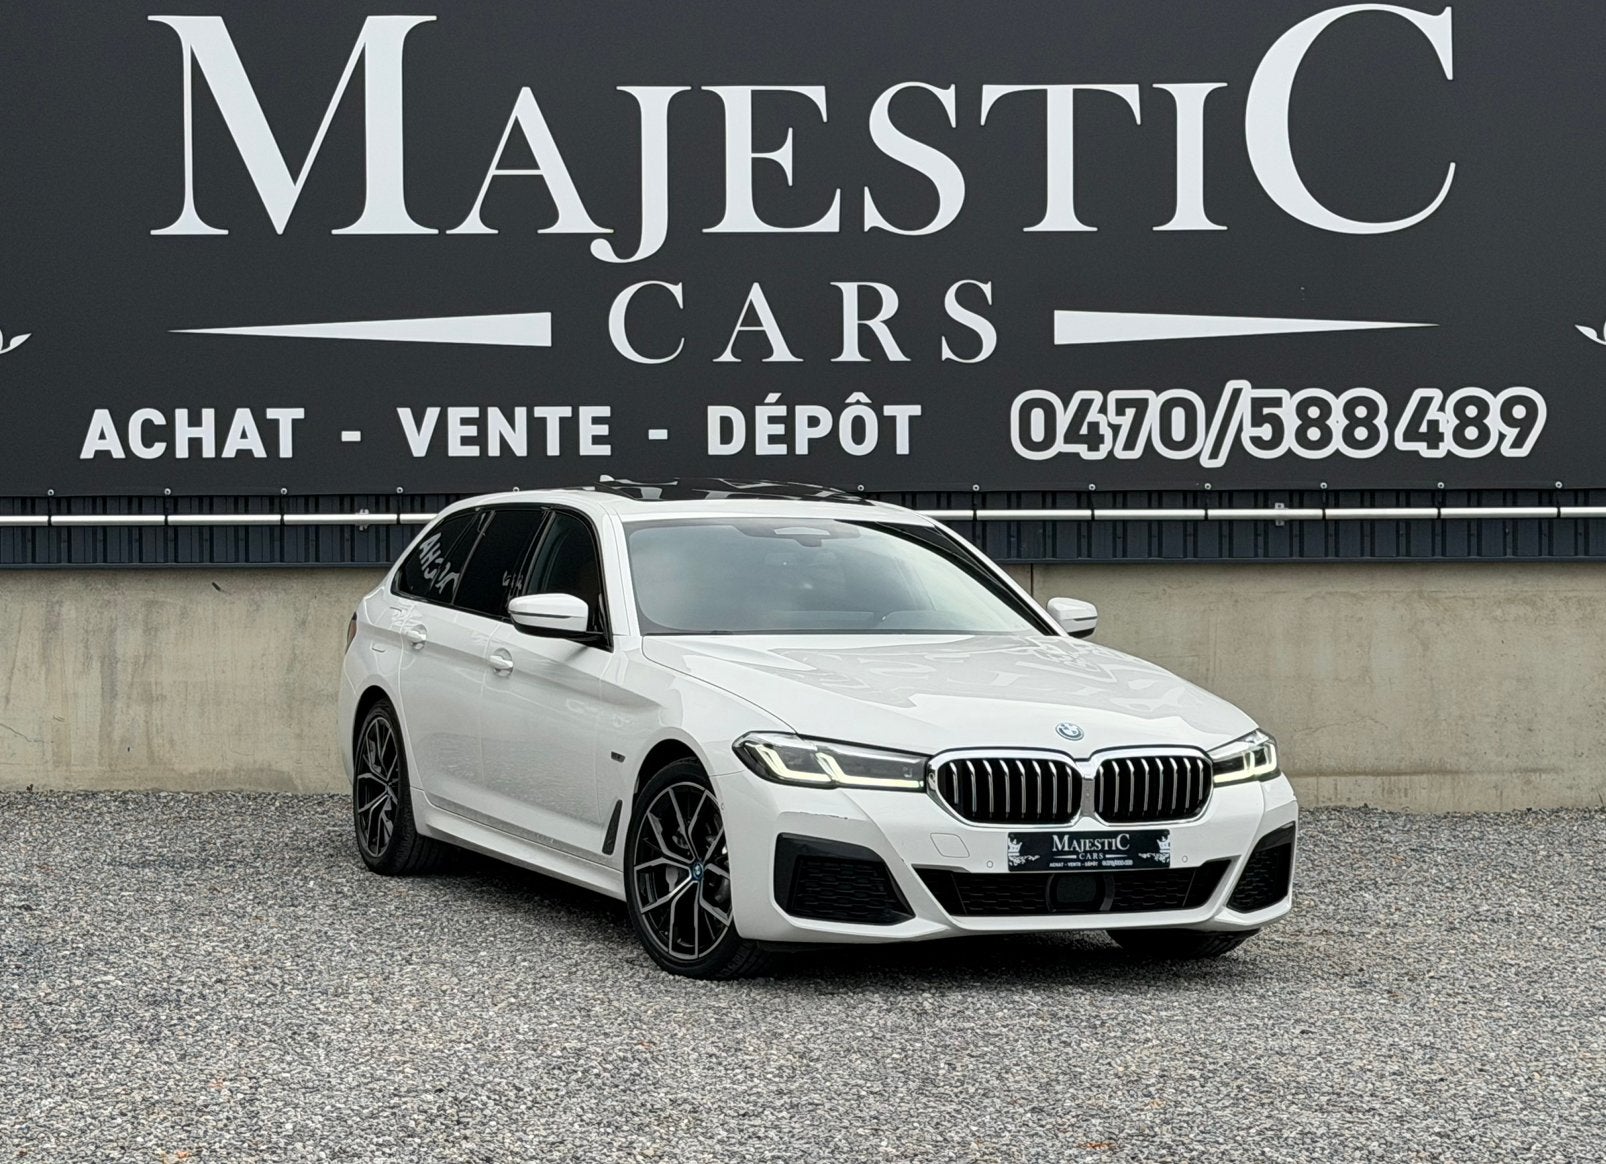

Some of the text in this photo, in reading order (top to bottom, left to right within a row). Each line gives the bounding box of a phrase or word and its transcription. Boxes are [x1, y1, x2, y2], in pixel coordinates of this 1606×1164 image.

[148, 4, 1456, 264] MAJESTIC
[608, 279, 997, 365] CARS
[79, 407, 305, 460] ACHAT
[396, 405, 612, 458] VENTE
[707, 391, 922, 456] DÉPÔT
[1078, 852, 1104, 860] CARS
